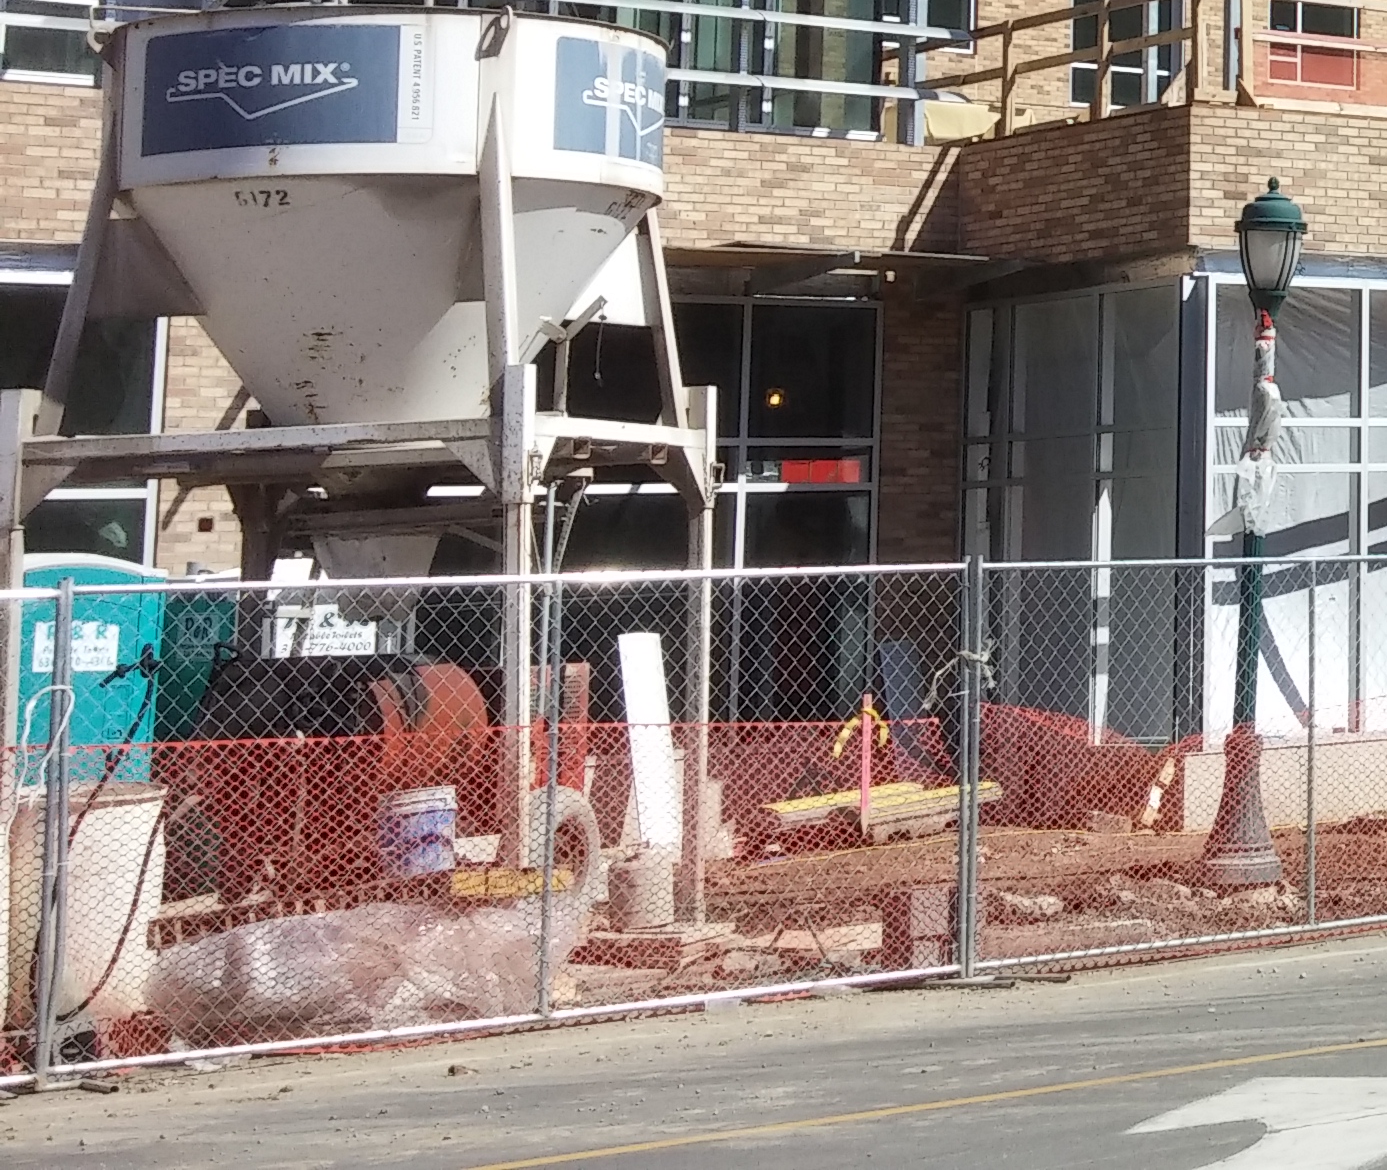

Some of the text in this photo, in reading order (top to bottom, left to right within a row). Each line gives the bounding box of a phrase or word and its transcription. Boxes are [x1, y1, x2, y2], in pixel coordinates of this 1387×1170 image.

[176, 61, 263, 93] SPEC
[412, 49, 422, 79] PATENT
[593, 76, 647, 106] SPEC
